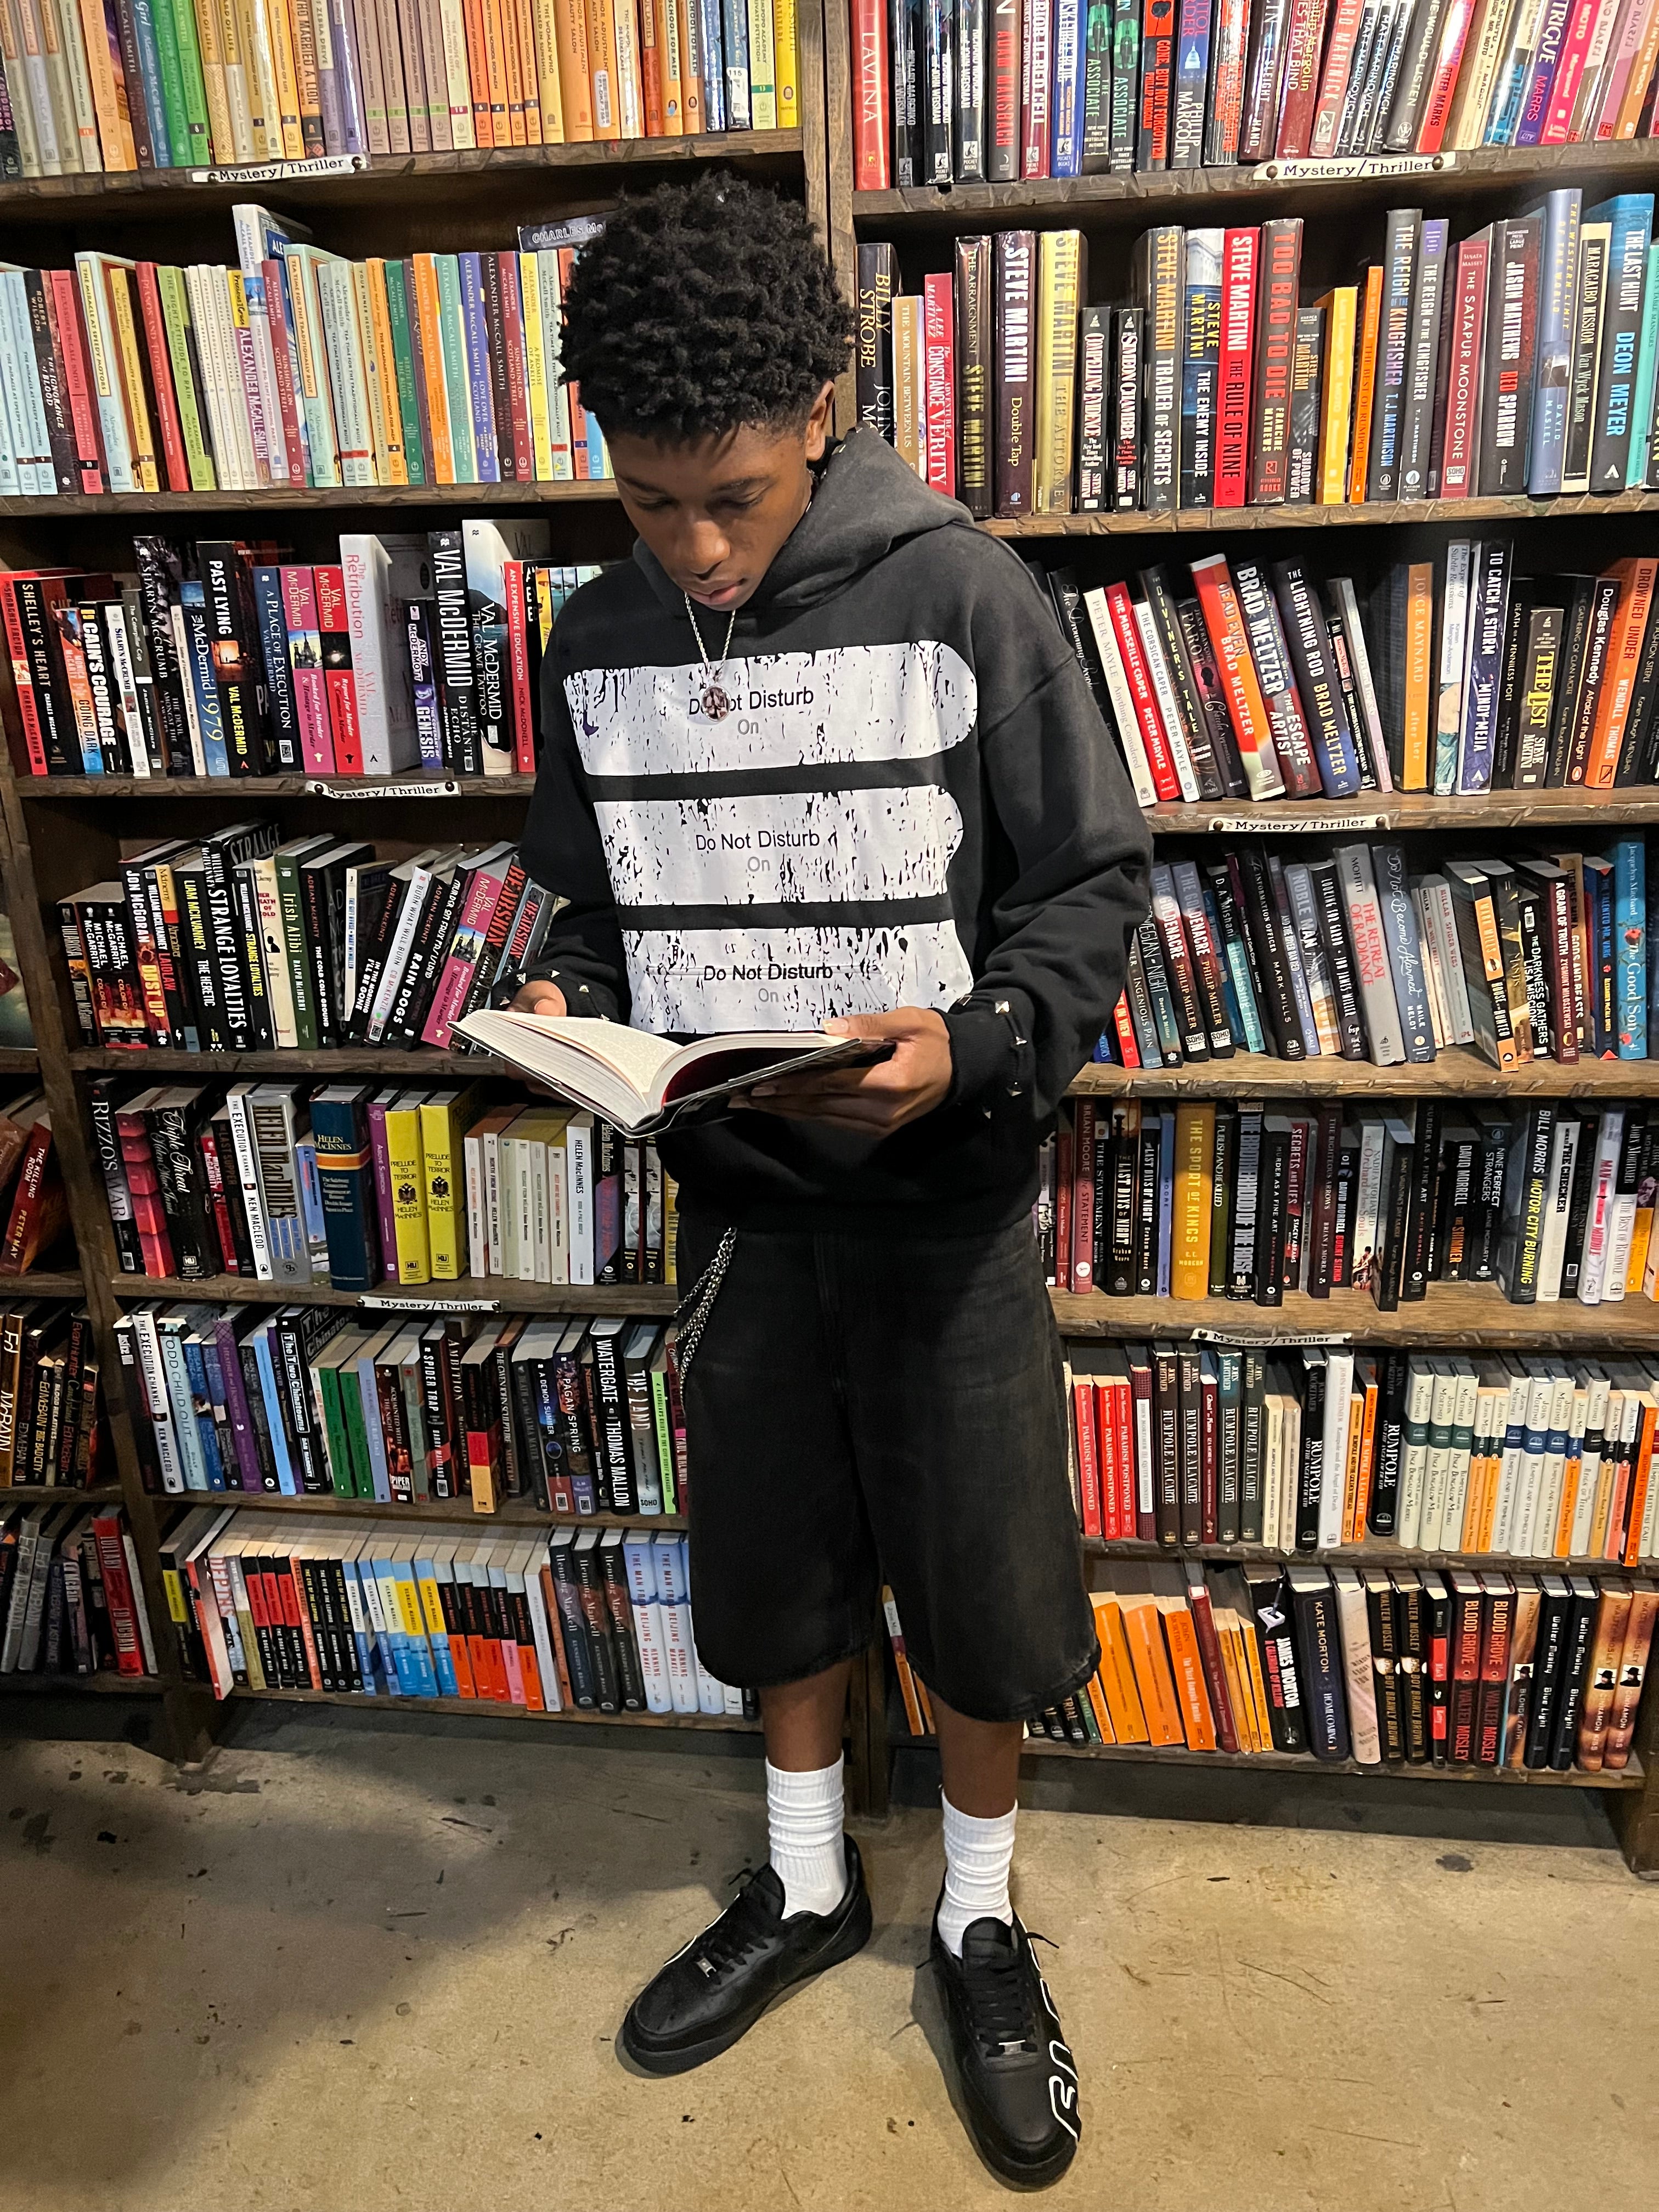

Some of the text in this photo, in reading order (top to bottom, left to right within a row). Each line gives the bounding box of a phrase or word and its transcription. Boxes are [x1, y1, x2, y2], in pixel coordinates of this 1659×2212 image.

[996, 74, 1014, 146] MANSBACH
[1087, 59, 1101, 117] ASSOCIATE
[1174, 91, 1193, 159] MARGOLIN
[1192, 101, 1204, 146] PHILLIP
[219, 157, 344, 182] Mystery/Thriller
[1283, 159, 1433, 177] Mystery/Thriller
[532, 227, 583, 244] CHARLES
[464, 259, 480, 375] ALEXANDER McCALL SMITH
[860, 289, 876, 368] STROBE
[876, 272, 890, 332] BILLY
[1005, 248, 1029, 382] STEVE MARTINI
[1265, 232, 1295, 399] TOO BAD TO DIE
[239, 329, 257, 395] ALEXANDER
[1153, 234, 1178, 486] STEVE MARTINI TRADER OF SECRETS
[1453, 270, 1476, 459] THE SATAPUR MOONSTONE
[1496, 262, 1525, 447] JASON MATTHEWS RED SPARROW
[1606, 332, 1635, 436] DEON MEYER
[42, 374, 54, 406] BLOOD
[50, 375, 65, 429] IGNORANCE
[248, 396, 262, 425] McCALL
[929, 346, 946, 486] CONSTANCE VERITY
[1222, 359, 1244, 478] THE RULE OF NINE
[252, 426, 269, 459] SMITH
[1007, 396, 1023, 467] Double Tap
[1486, 568, 1503, 604] CATCH
[1490, 552, 1504, 565] TO
[209, 561, 232, 634] PAST LYING
[346, 554, 363, 639] Retribution
[433, 549, 473, 687] VAL McDERMID
[1288, 569, 1324, 678] THE LIGHTNING ROD
[1114, 593, 1148, 699] THE MARSEILLE CAPER
[1237, 566, 1284, 696] BRAD MELTZER
[1482, 618, 1497, 656] STORM
[1587, 588, 1613, 686] Douglas Kennedy
[82, 624, 116, 745] CAIN'S COURAGE
[193, 624, 223, 741] McDermid 1979
[750, 686, 815, 709] Disturb
[1526, 651, 1554, 727] THE LIST
[228, 686, 247, 755] VAL McDERMID
[737, 719, 759, 735] On
[1473, 684, 1492, 752] MINDY MEJIA
[1604, 679, 1629, 759] WENDALL THOMAS
[696, 830, 820, 851] Do Not Disturb
[1235, 819, 1367, 831] Mystery/Thriller
[747, 856, 770, 872] On
[283, 892, 303, 953] Irish Alibi
[1181, 871, 1210, 957] THE GOLDENACRE
[1556, 889, 1566, 916] GRAIN
[1557, 916, 1567, 927] OF
[208, 889, 246, 1028] STRANGE LOYALTIES
[703, 963, 833, 981] Do Not Disturb
[1558, 927, 1568, 956] TRUTH
[141, 964, 165, 1017] DUST UP
[393, 953, 423, 1024] RAIN DOGS
[758, 988, 779, 1002] On
[1202, 961, 1222, 1025] PHILIP MILLER
[1627, 943, 1640, 1031] The Good Son
[25, 1156, 35, 1182] ROOM
[28, 1166, 41, 1199] KILLING
[92, 1101, 126, 1217] RIZZO'S WAR
[1186, 1120, 1203, 1244] THE SPORT OF KINGS
[1521, 1109, 1551, 1284] BILL MORRIS MOTOR CITY BURNING
[10, 1209, 27, 1259] PETER MAY
[381, 1299, 483, 1311] Mystery/Thriller
[1214, 1332, 1330, 1347] Mystery/Thriller
[563, 1378, 581, 1453] PAGAN SPRING
[596, 1340, 630, 1507] WATERGATE THOMAS MALLON
[1309, 1441, 1323, 1505] RUMPOLE
[641, 1612, 651, 1642] BEIJING
[1462, 1600, 1479, 1665] BLOOD GROVE
